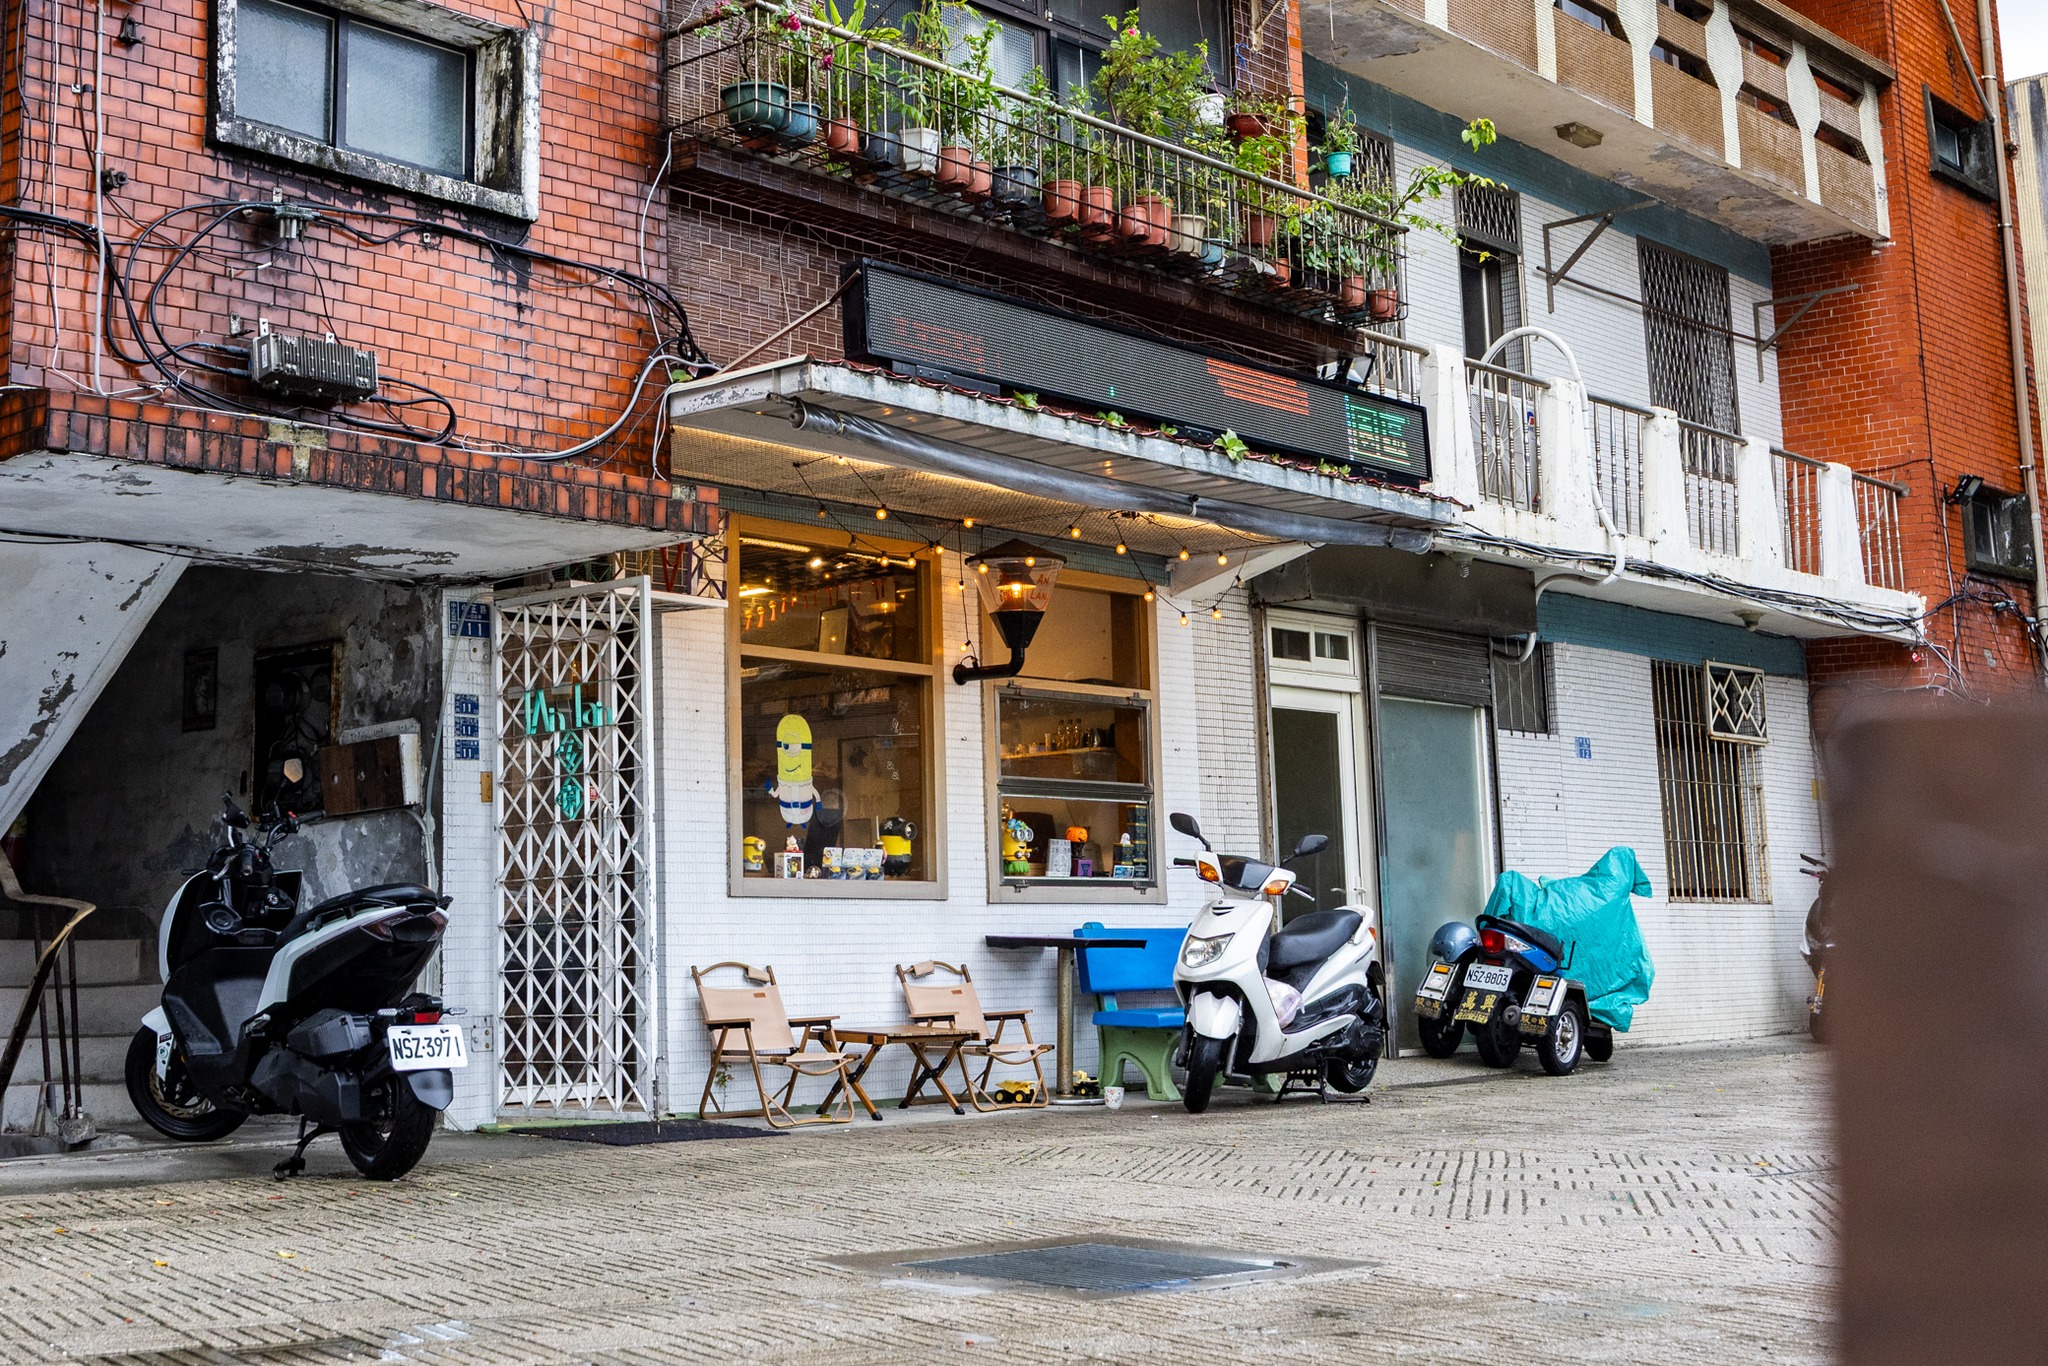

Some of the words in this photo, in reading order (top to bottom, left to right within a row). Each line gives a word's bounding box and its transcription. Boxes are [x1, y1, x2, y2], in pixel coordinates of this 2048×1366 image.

[467, 622, 482, 637] 11
[462, 703, 472, 713] 11
[462, 725, 471, 735] 11
[463, 748, 472, 758] 11
[1582, 749, 1590, 758] 12
